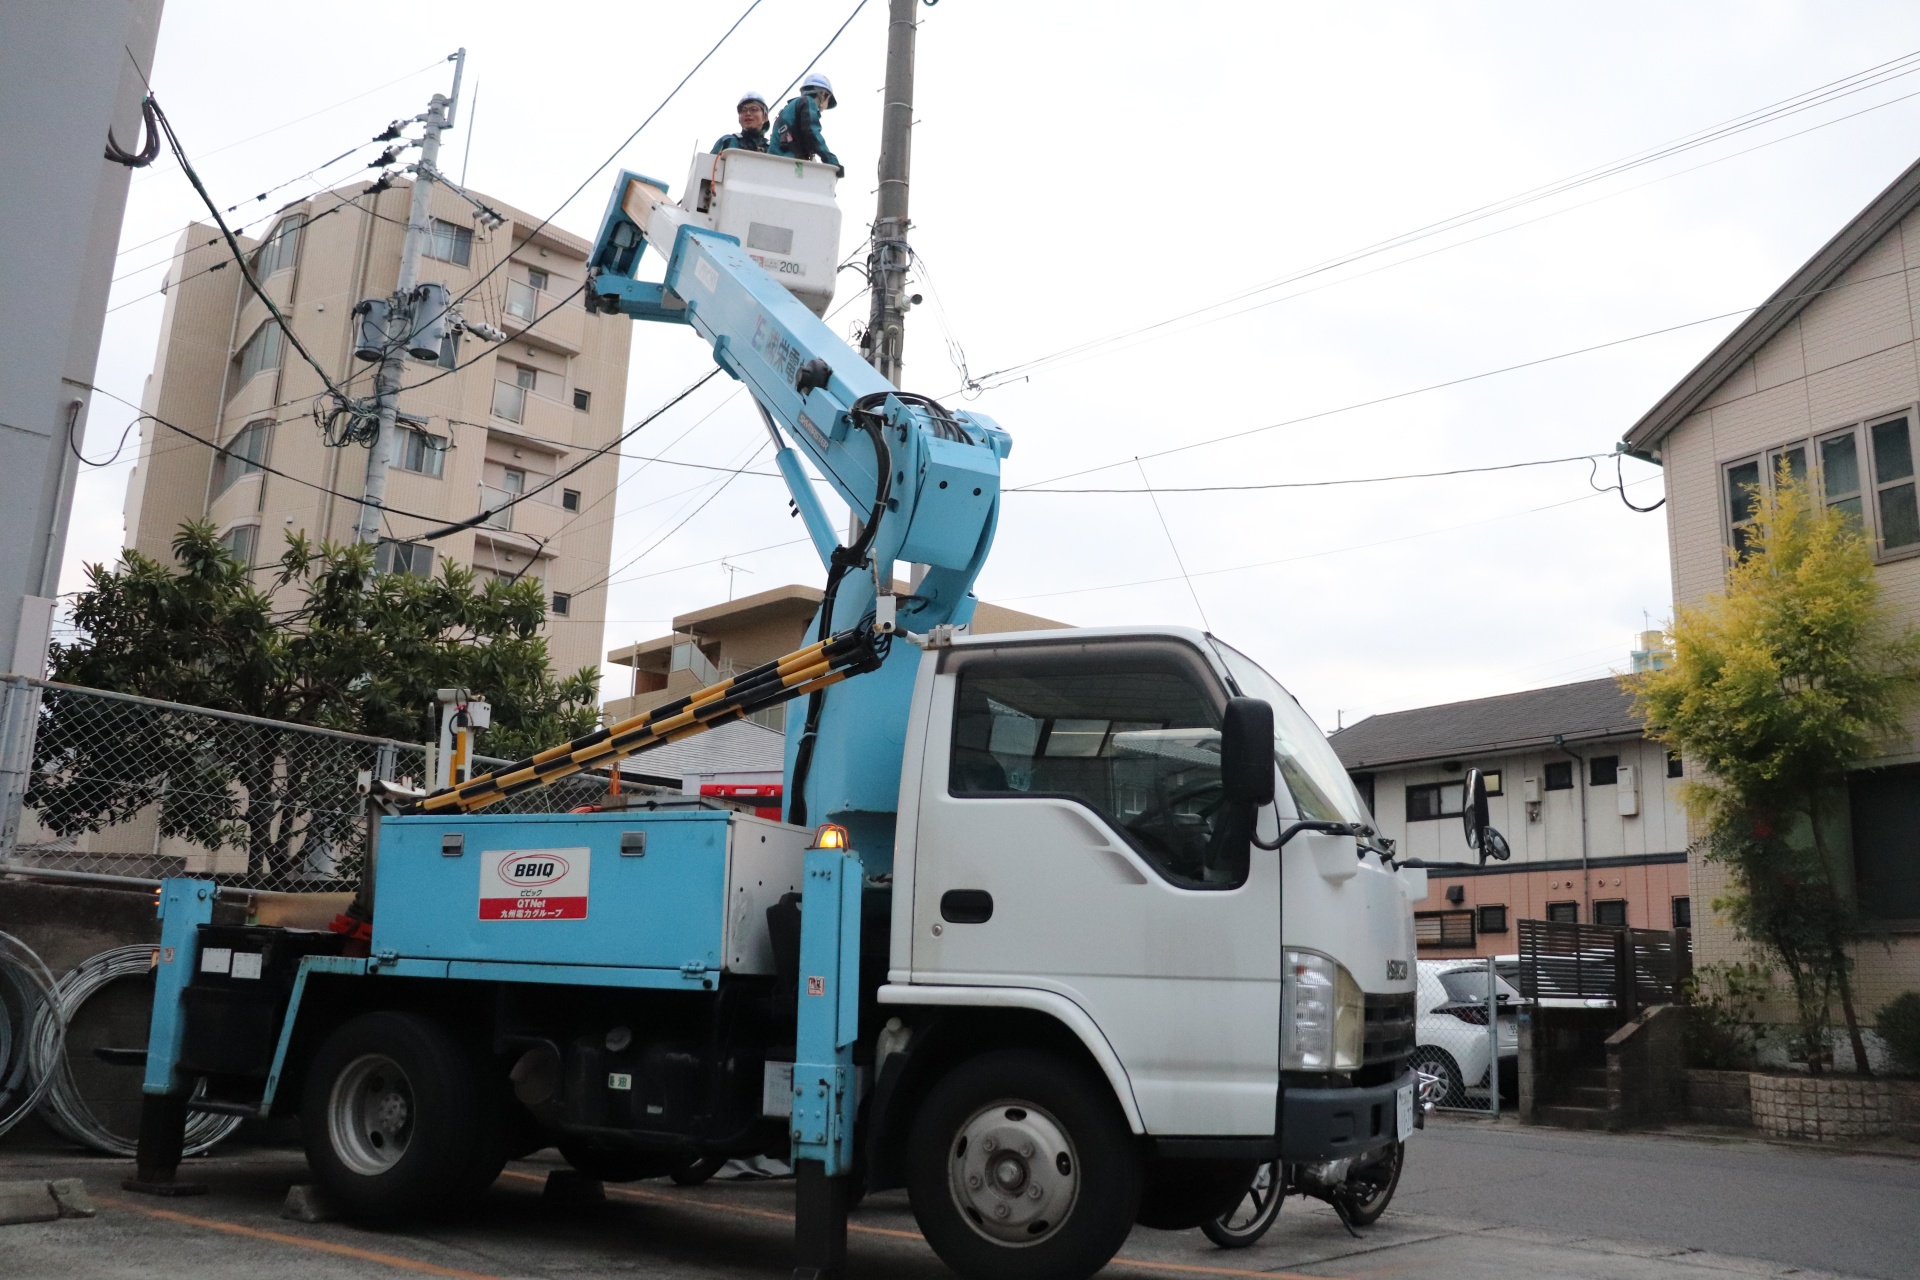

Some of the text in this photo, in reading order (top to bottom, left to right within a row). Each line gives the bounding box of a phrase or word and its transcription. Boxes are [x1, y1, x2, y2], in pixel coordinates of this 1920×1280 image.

[779, 261, 799, 274] 200
[515, 863, 554, 877] BBIQ
[517, 899, 546, 908] QTNet
[500, 909, 563, 919] 九州電力グループ
